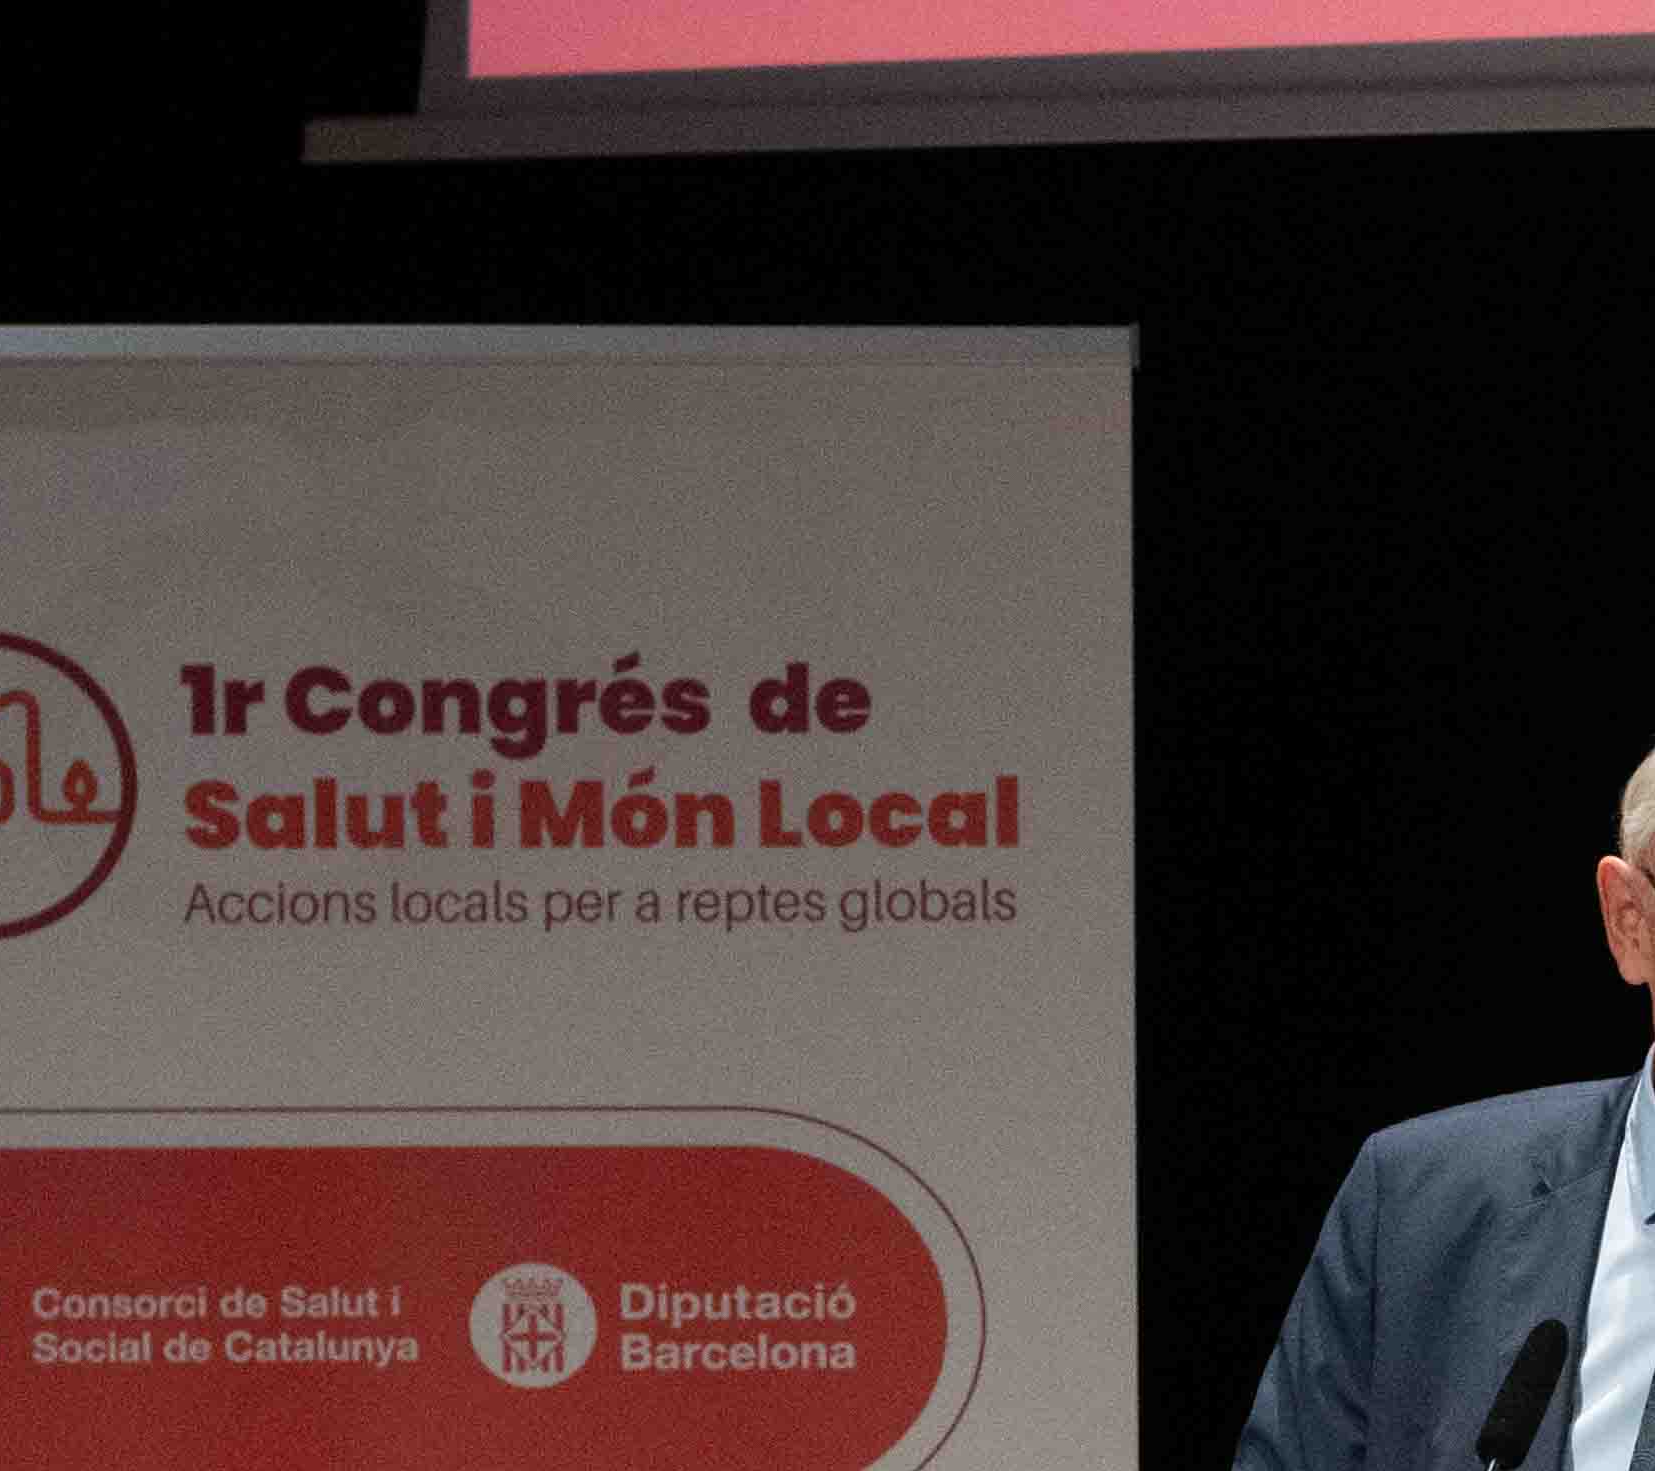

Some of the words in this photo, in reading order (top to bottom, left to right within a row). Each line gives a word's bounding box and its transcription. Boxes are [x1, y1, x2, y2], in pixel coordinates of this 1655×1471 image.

[180, 664, 265, 736] 1r
[284, 652, 711, 761] Congrés
[749, 661, 871, 734] de
[184, 777, 448, 850] Salut
[471, 772, 496, 849] i
[519, 766, 735, 849] Món
[759, 775, 1019, 848] Local
[183, 882, 378, 926] Accions
[390, 879, 529, 925] locals
[543, 889, 622, 933] per
[634, 888, 662, 924] a
[676, 883, 827, 933] reptes
[838, 877, 1018, 934] globals
[31, 1286, 208, 1321] Consorci
[219, 1287, 268, 1319] de
[280, 1285, 380, 1319] Salut
[390, 1286, 402, 1317] i
[620, 1282, 857, 1325] Diputació
[32, 1331, 152, 1364] Social
[162, 1331, 212, 1363] de
[223, 1329, 420, 1369] Catalunya
[620, 1331, 857, 1371] Barcelona
